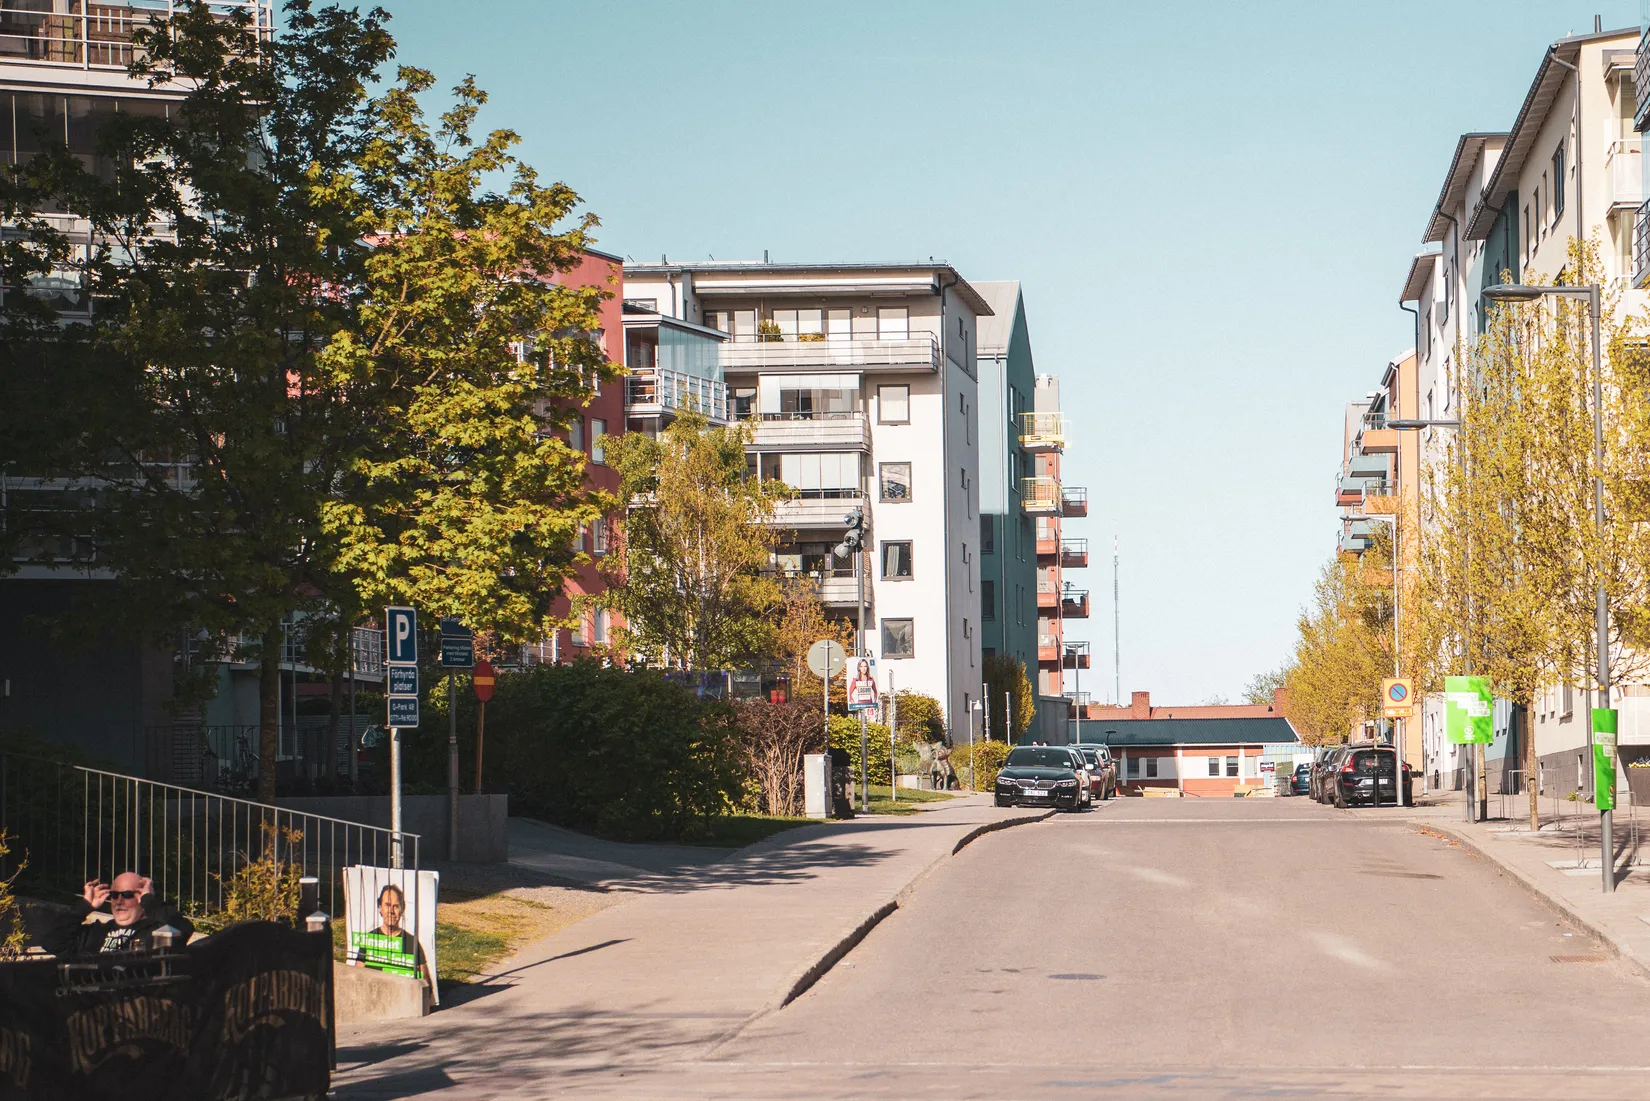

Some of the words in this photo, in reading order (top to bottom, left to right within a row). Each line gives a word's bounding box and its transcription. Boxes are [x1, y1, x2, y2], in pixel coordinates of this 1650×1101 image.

[395, 614, 410, 657] P
[391, 669, 415, 680] Förhyrda
[394, 682, 413, 692] platser
